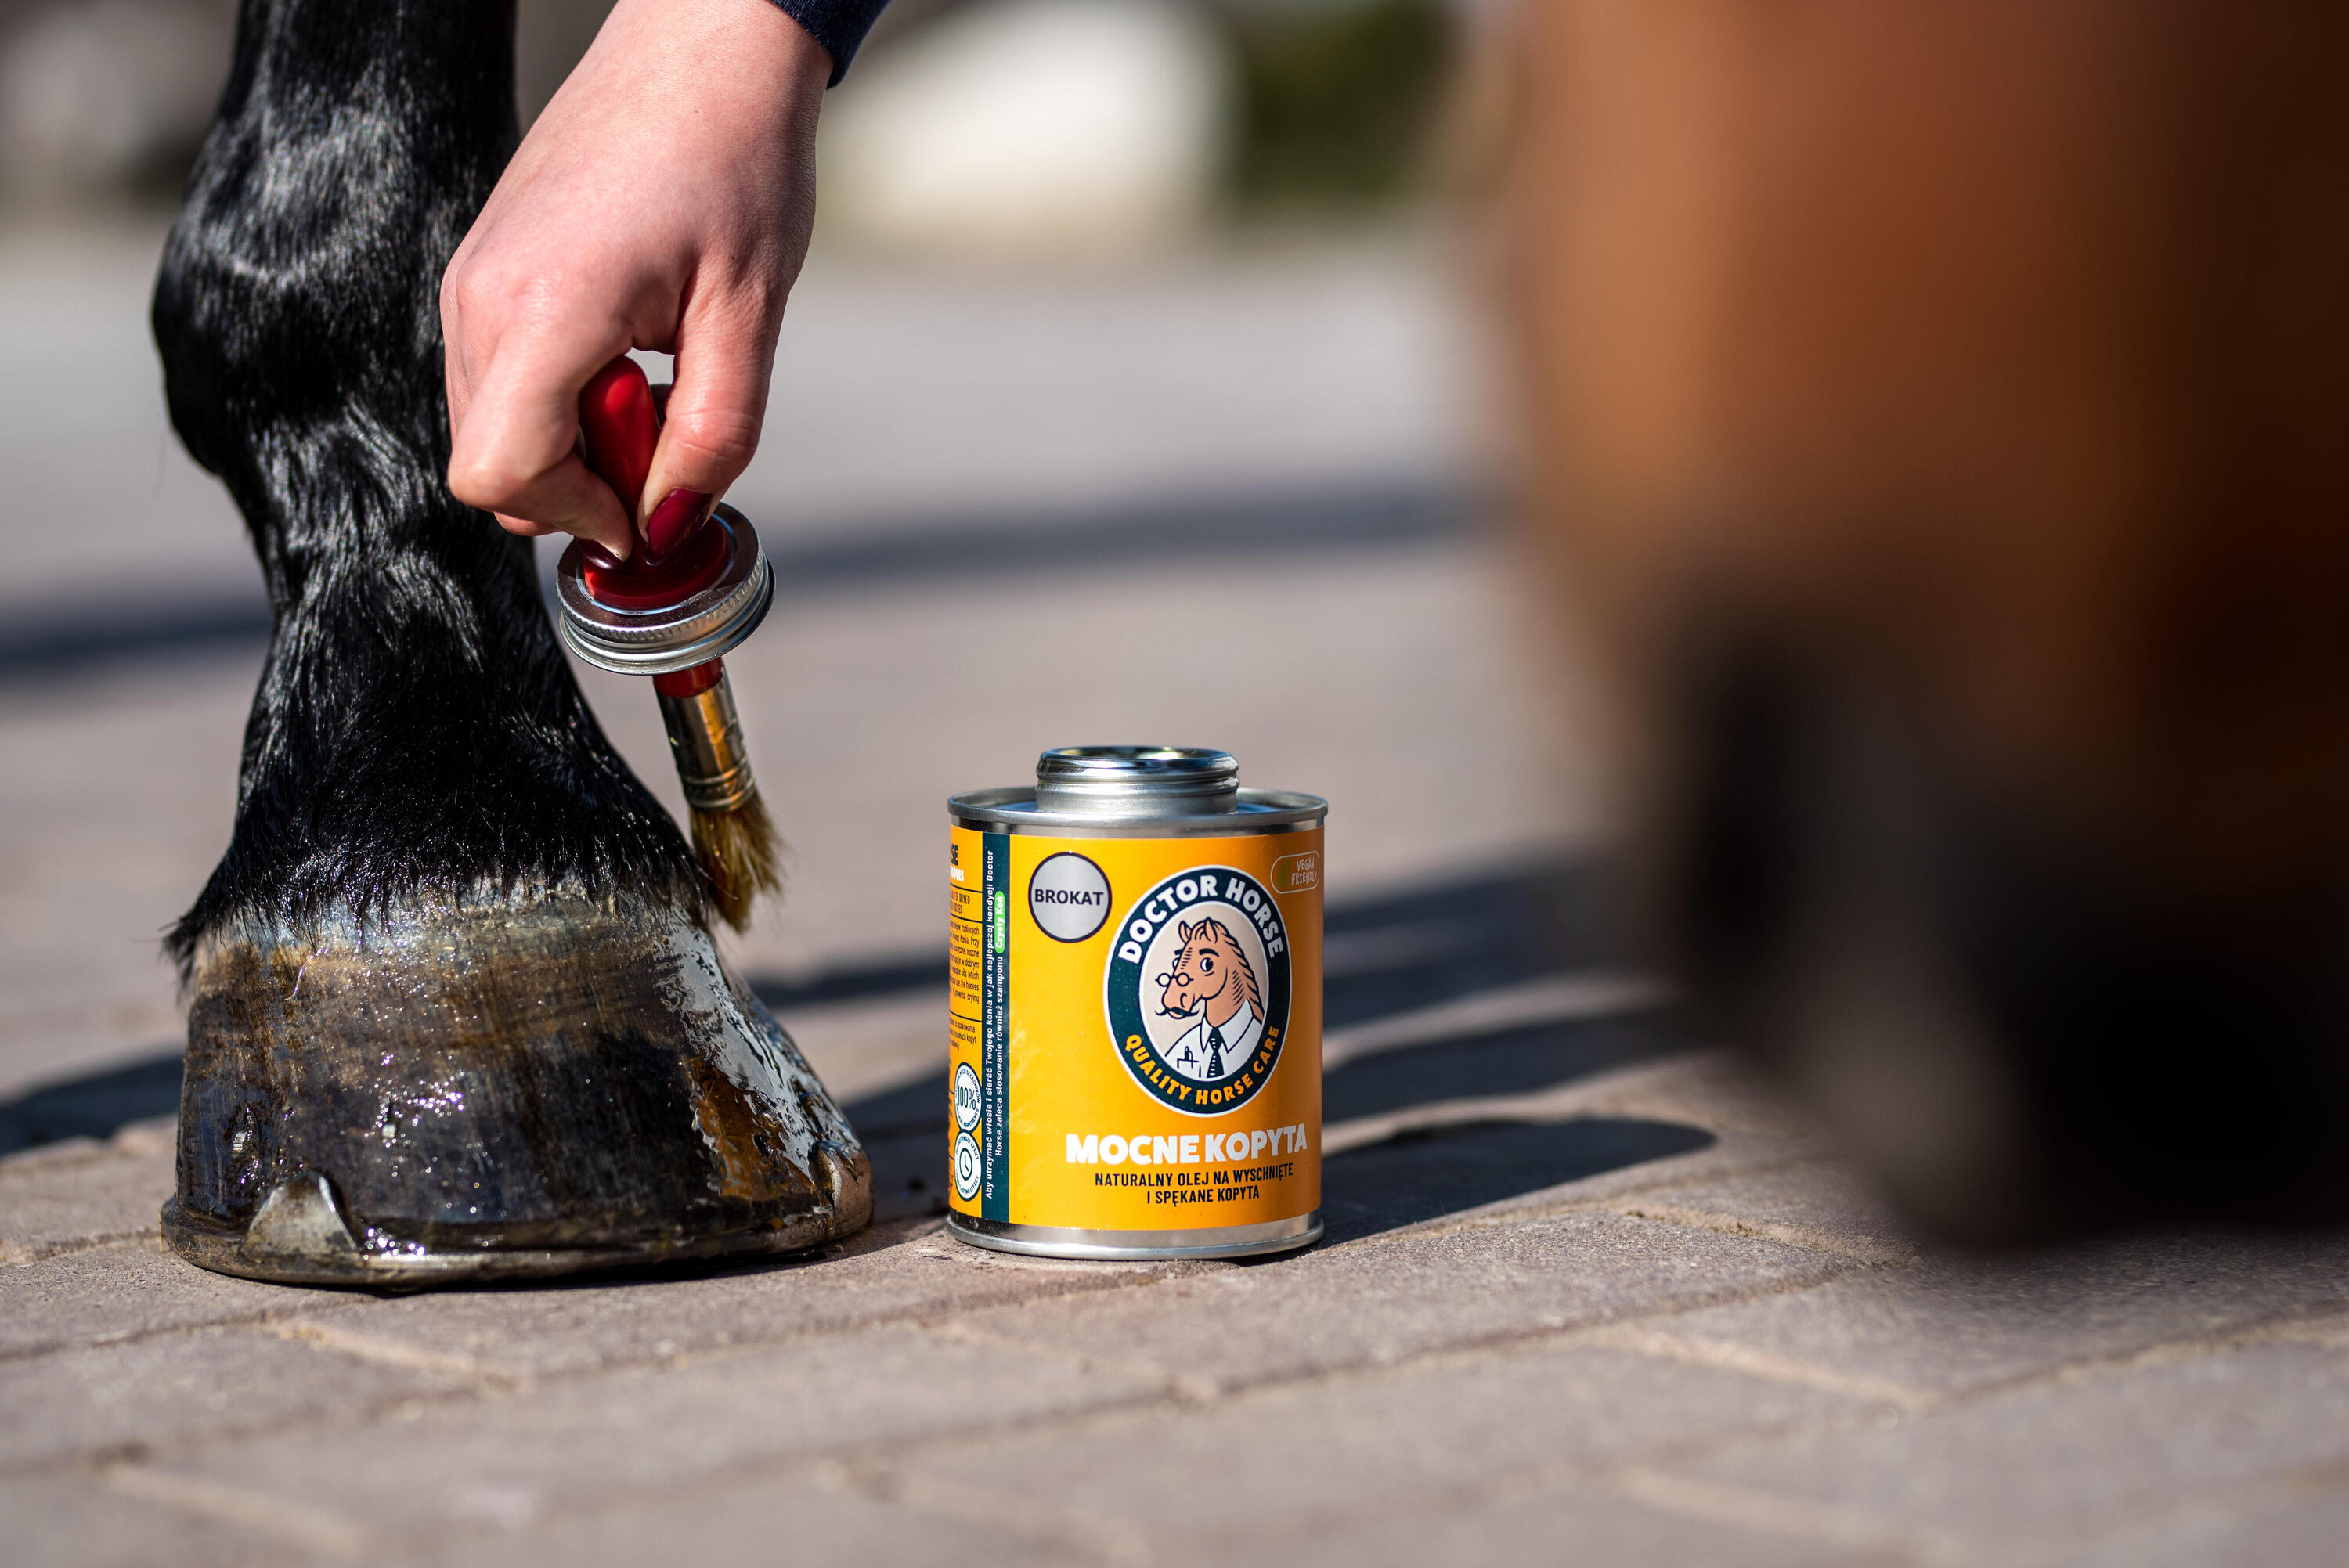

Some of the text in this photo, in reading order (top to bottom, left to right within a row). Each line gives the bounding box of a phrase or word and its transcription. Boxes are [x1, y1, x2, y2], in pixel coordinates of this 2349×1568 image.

[1297, 857, 1315, 871] VEGAN
[1291, 871, 1318, 886] FRIENDLY
[986, 884, 994, 922] kondycji
[995, 896, 1004, 915] Koń
[1034, 889, 1104, 906] BROKAT
[1118, 874, 1284, 964] DOCTOR HORSE
[995, 917, 1005, 949] Czysty
[986, 925, 994, 971] najlepszej
[987, 989, 993, 998] w
[1125, 1026, 1280, 1105] QUALITY HORSE CARE
[958, 1085, 976, 1111] 100%
[1066, 1123, 1308, 1165] MOCNE KOPYTA
[1095, 1162, 1294, 1187] NATURALNY OLEJ NA WYSCHNIĘTE
[1146, 1185, 1260, 1207] I SPĘKANE KOPYTA
